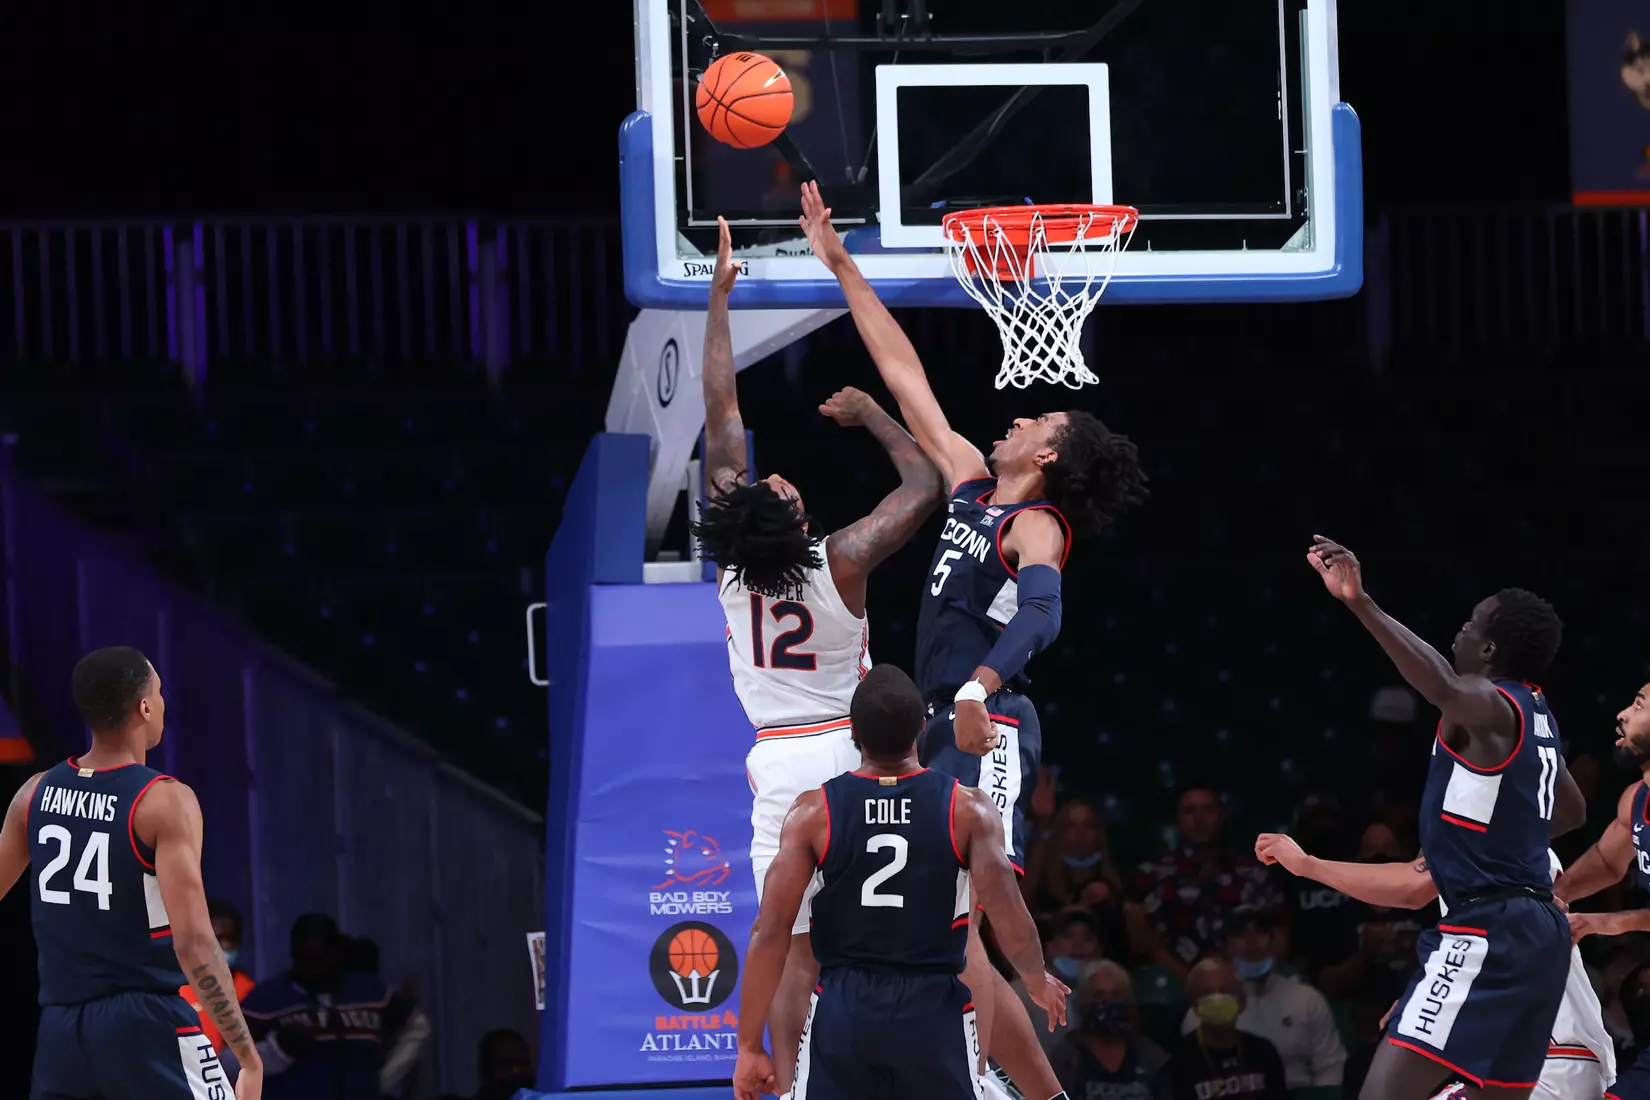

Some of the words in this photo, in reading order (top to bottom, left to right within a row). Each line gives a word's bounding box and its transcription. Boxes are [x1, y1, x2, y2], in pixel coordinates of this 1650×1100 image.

[683, 262, 749, 277] SPALG
[930, 549, 963, 597] 5
[750, 592, 816, 671] 12
[991, 733, 1007, 815] SKIES
[40, 785, 118, 822] HAWKINS
[864, 797, 912, 825] COLE
[38, 824, 113, 911] 24
[861, 833, 908, 908] 2
[649, 891, 688, 903] BAD
[692, 891, 731, 902] BOY
[650, 902, 733, 915] MOWERS
[1415, 939, 1471, 1035] HUSKES
[655, 1014, 722, 1031] BATTLE
[722, 1010, 739, 1029] 4
[639, 1032, 738, 1051] ATLANT
